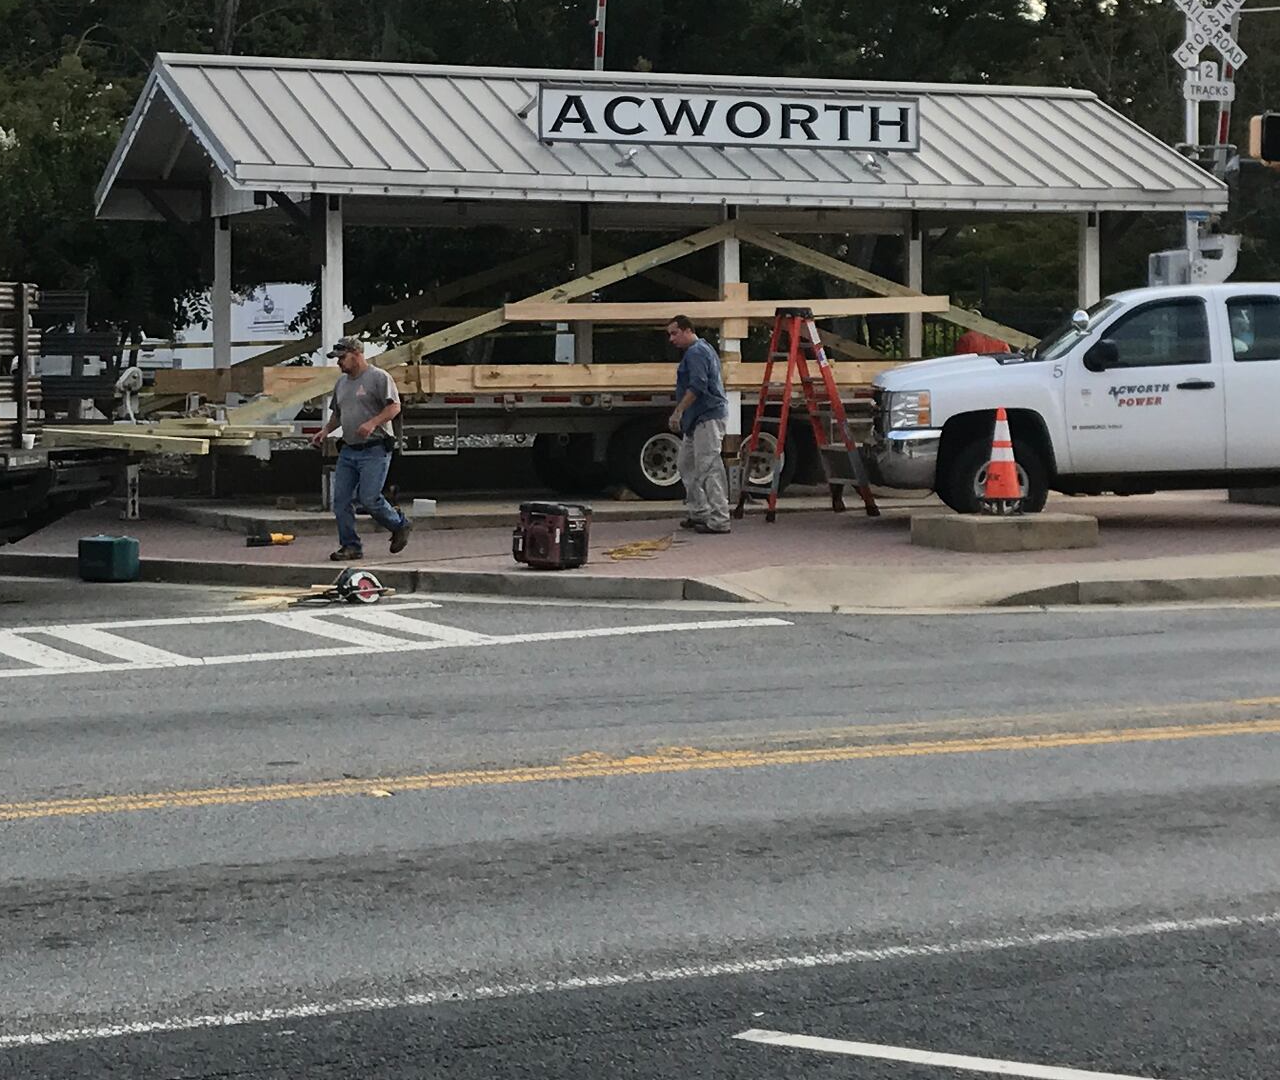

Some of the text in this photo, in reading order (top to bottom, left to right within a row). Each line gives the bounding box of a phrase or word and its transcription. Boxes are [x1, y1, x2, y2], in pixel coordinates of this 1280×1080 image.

[1205, 64, 1214, 78] 2
[1190, 84, 1229, 96] TRACKS
[548, 95, 911, 143] ACWORTH
[1053, 364, 1063, 378] 5
[1108, 384, 1170, 396] ACWORTH
[1118, 397, 1162, 407] POWER
